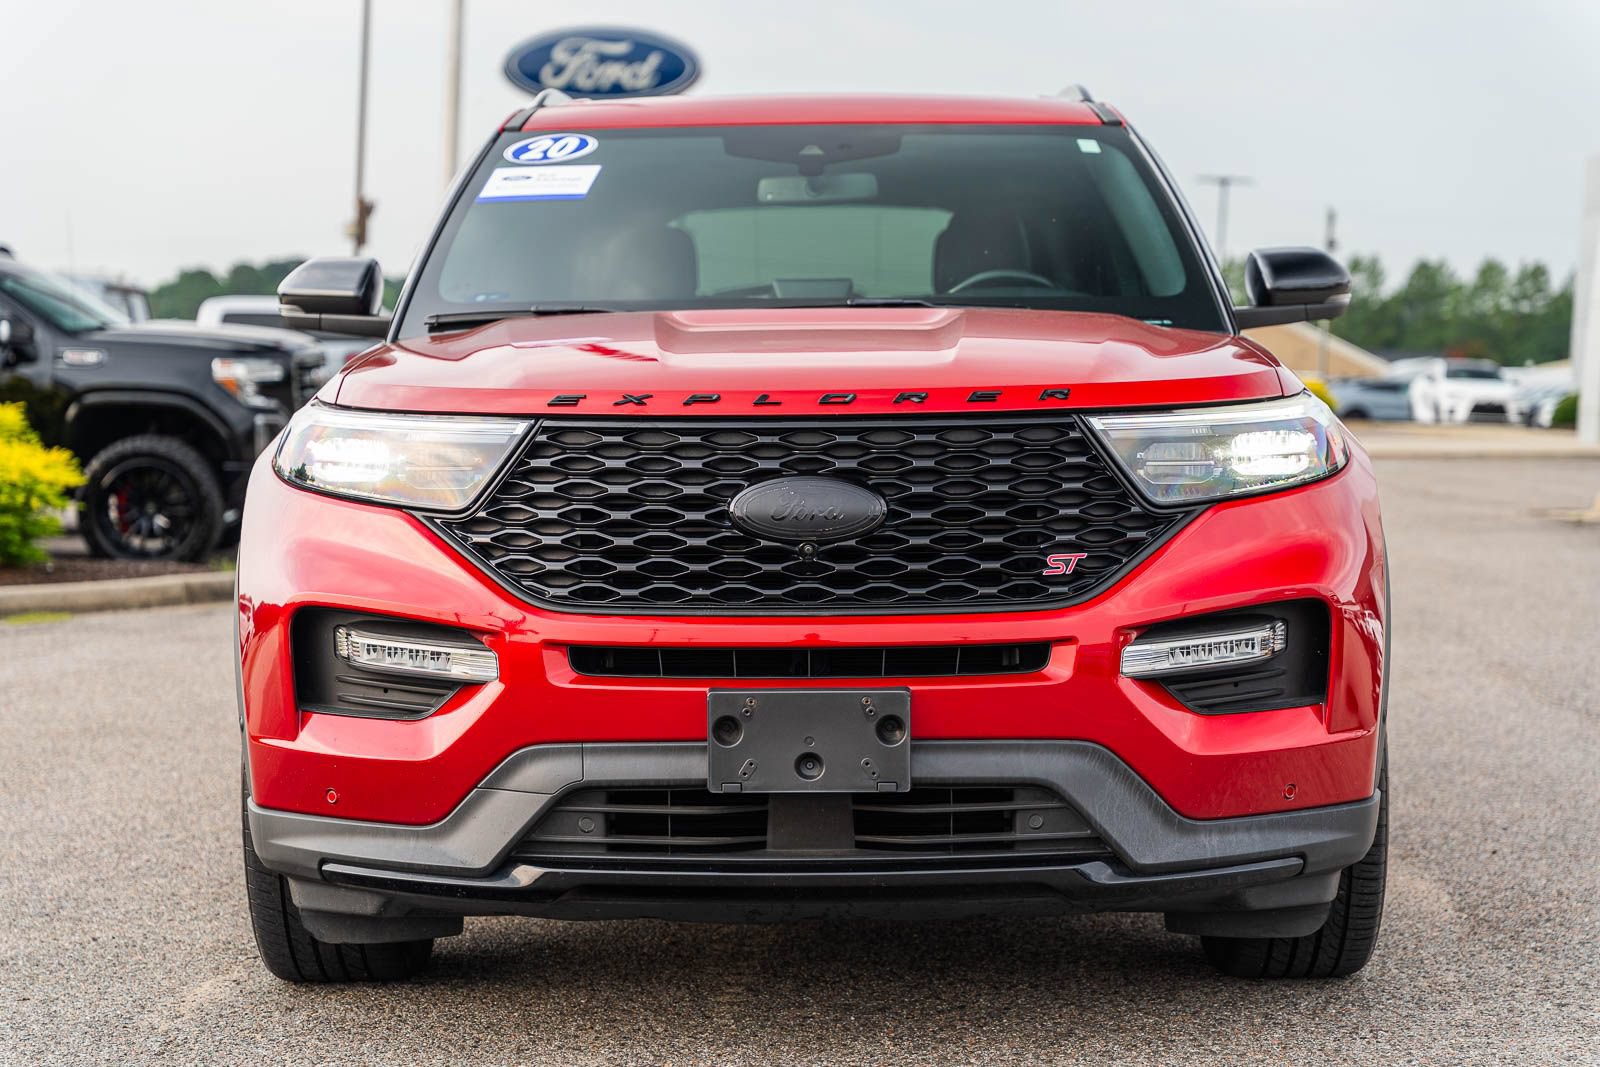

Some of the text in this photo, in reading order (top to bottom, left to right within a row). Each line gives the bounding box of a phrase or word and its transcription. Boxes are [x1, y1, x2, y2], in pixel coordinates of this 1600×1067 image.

[540, 36, 664, 92] Ford
[518, 136, 578, 161] 20
[546, 387, 1073, 407] EXPLORER
[768, 489, 850, 523] Ford
[1042, 553, 1088, 575] ST
